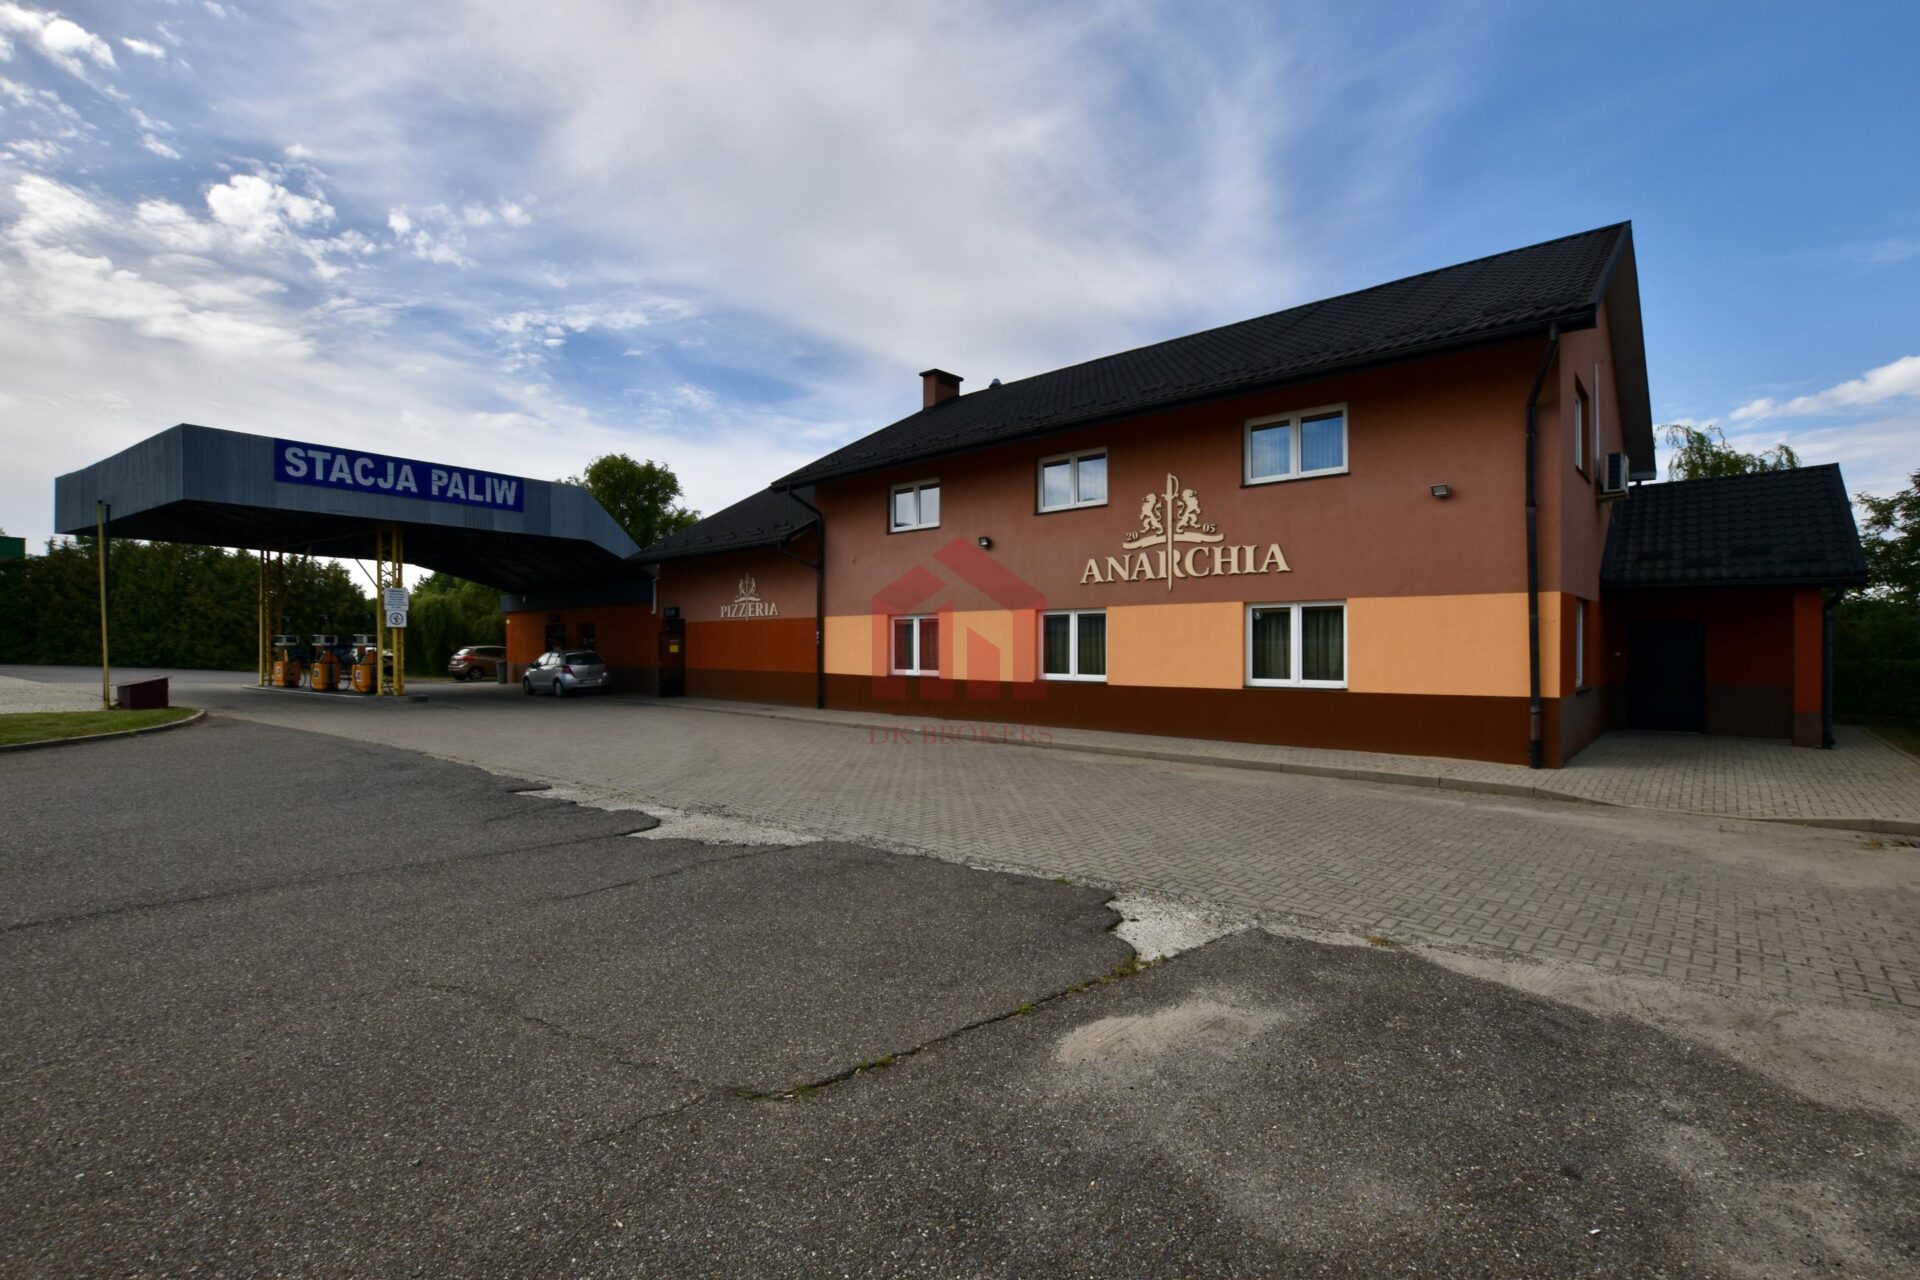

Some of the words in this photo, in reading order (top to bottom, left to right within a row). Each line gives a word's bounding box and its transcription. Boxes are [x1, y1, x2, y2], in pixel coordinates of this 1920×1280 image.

[284, 446, 418, 493] STACJA
[431, 469, 517, 506] PALIW
[1125, 530, 1139, 541] 20
[1202, 523, 1216, 533] 05
[1080, 543, 1292, 584] ANARCHIA
[720, 602, 778, 618] PIZZERIA
